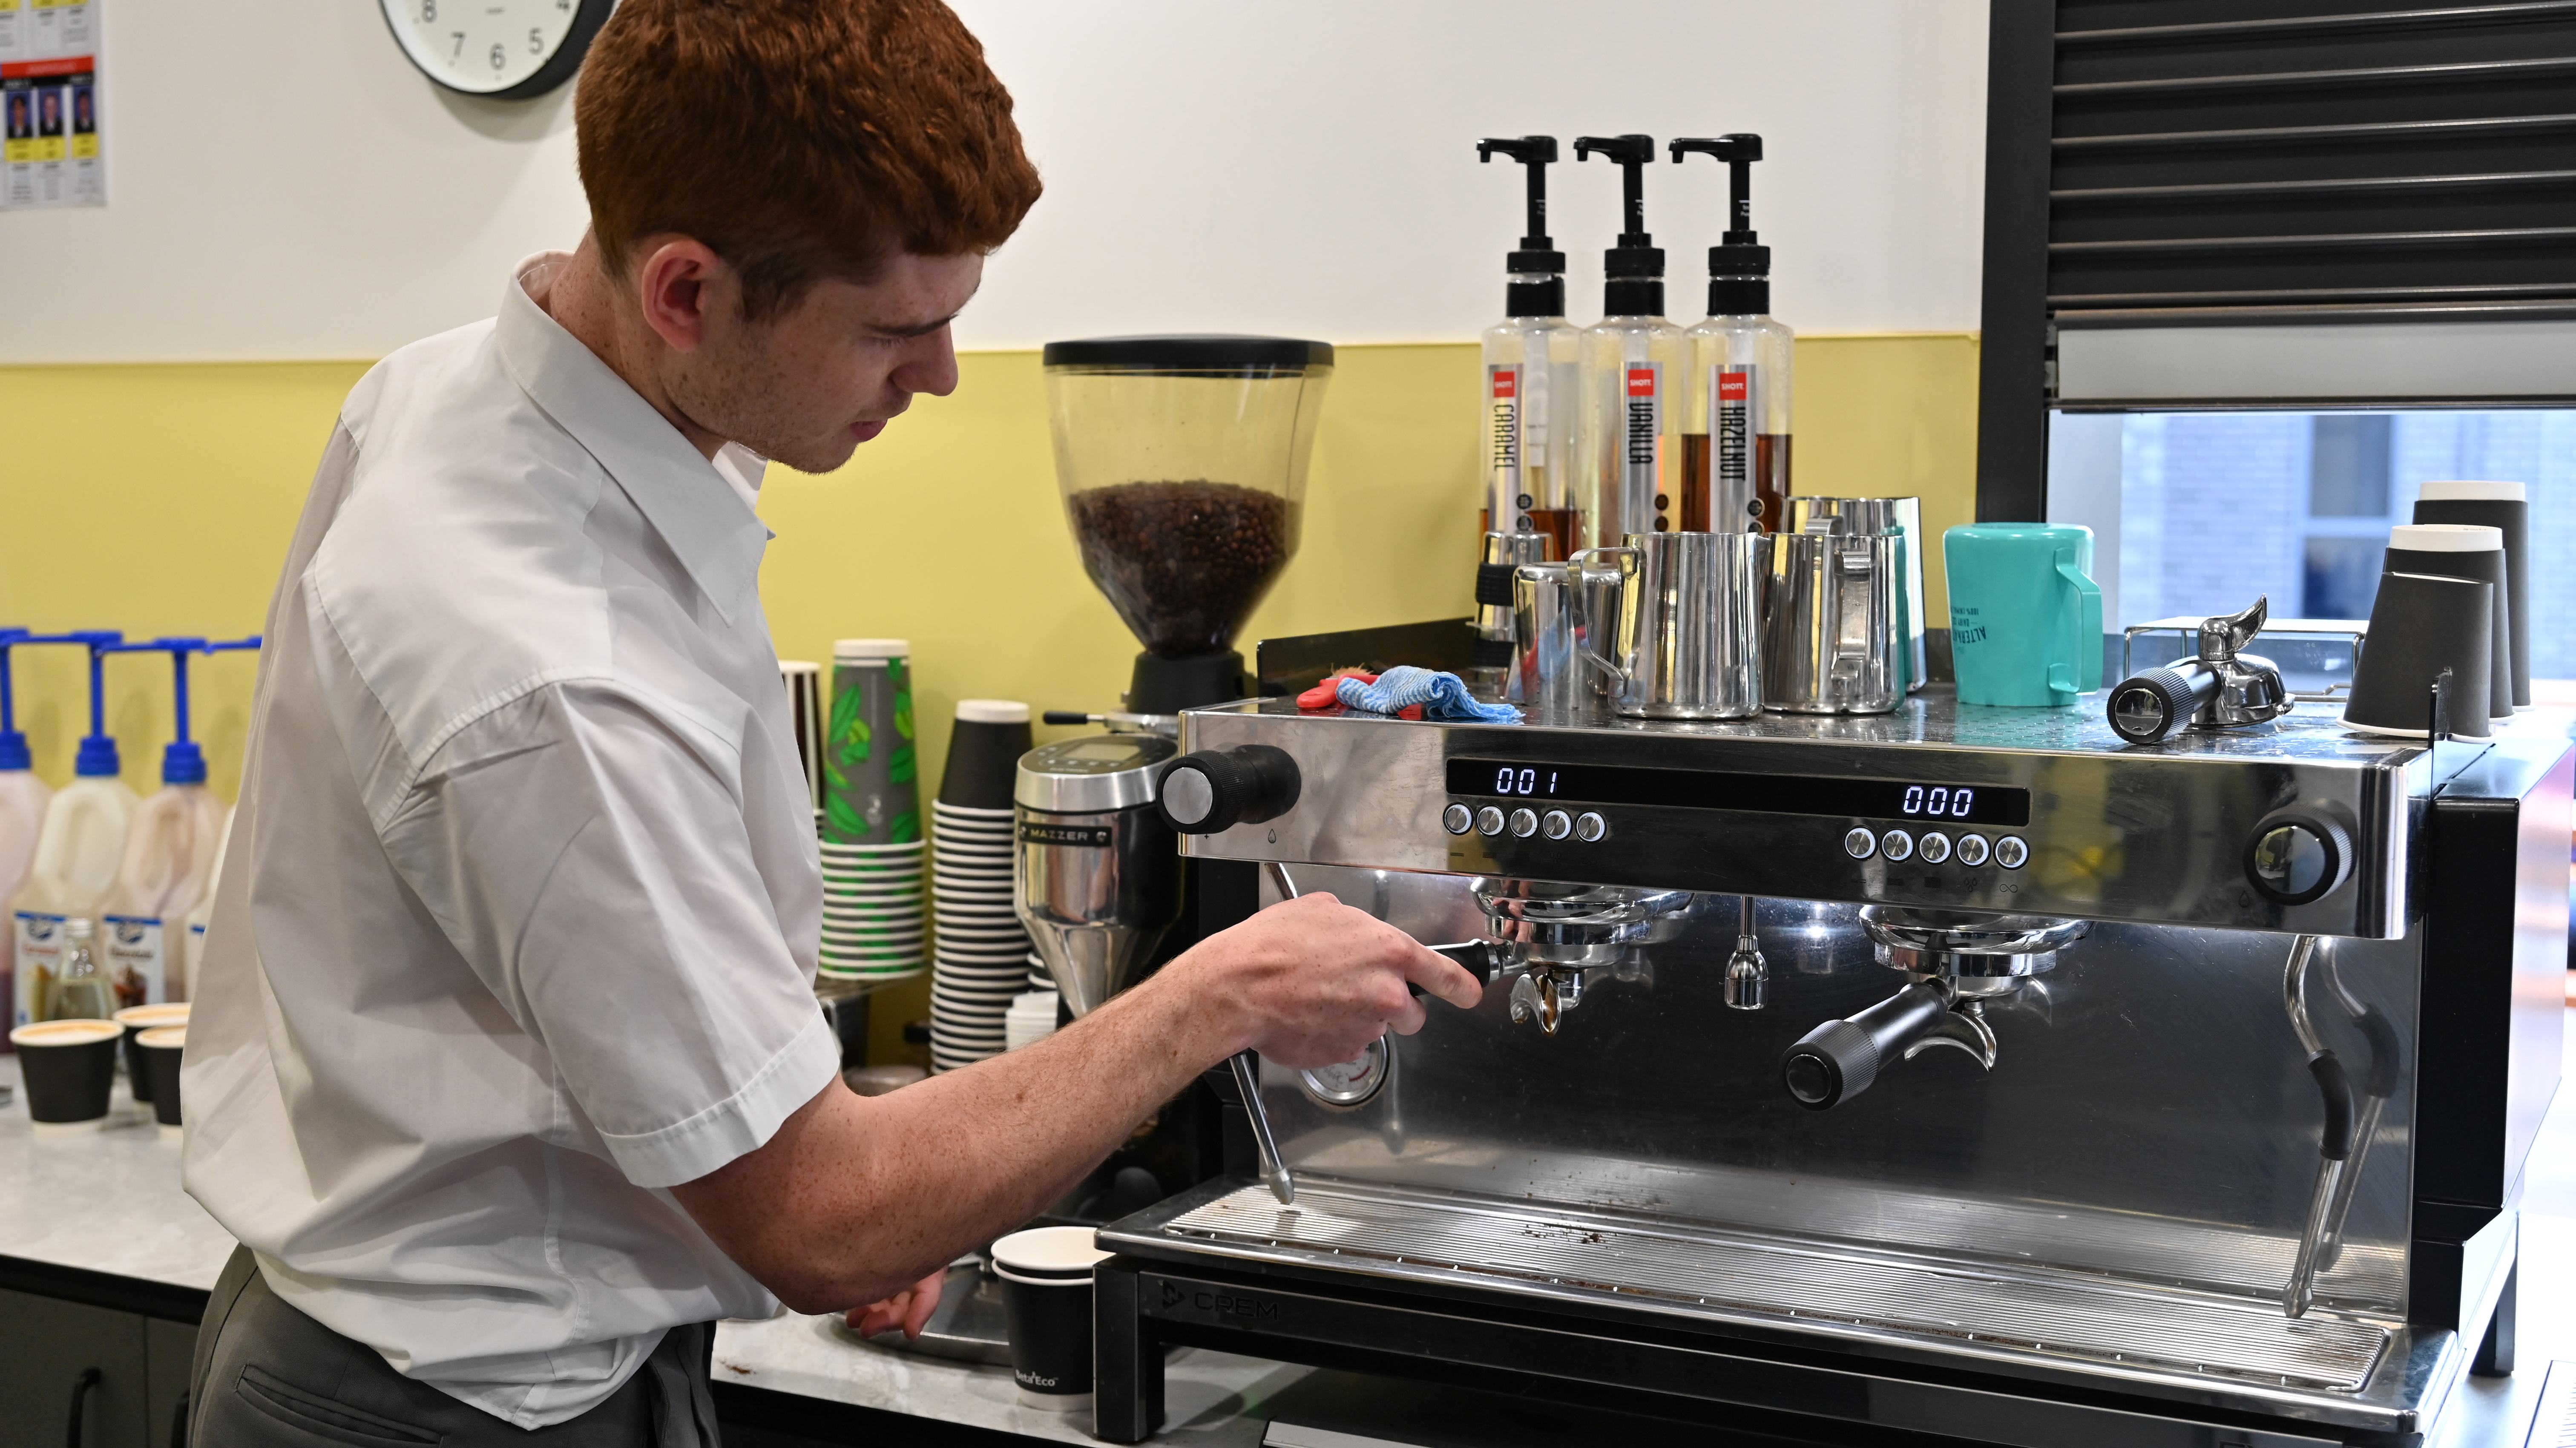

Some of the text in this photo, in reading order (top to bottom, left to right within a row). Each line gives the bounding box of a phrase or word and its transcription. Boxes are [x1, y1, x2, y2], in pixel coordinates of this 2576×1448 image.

[422, 0, 437, 23] 8
[450, 32, 466, 58] 7
[528, 28, 544, 55] 5
[489, 43, 506, 70] 6
[1494, 405, 1515, 471] CARAMEL
[1629, 403, 1653, 463] VANILLA
[1720, 407, 1746, 481] HAZELNUT
[1496, 767, 1557, 794] 001
[1903, 787, 1972, 816] 000
[1030, 829, 1088, 841] MAZZER
[1194, 1292, 1278, 1321] CREM
